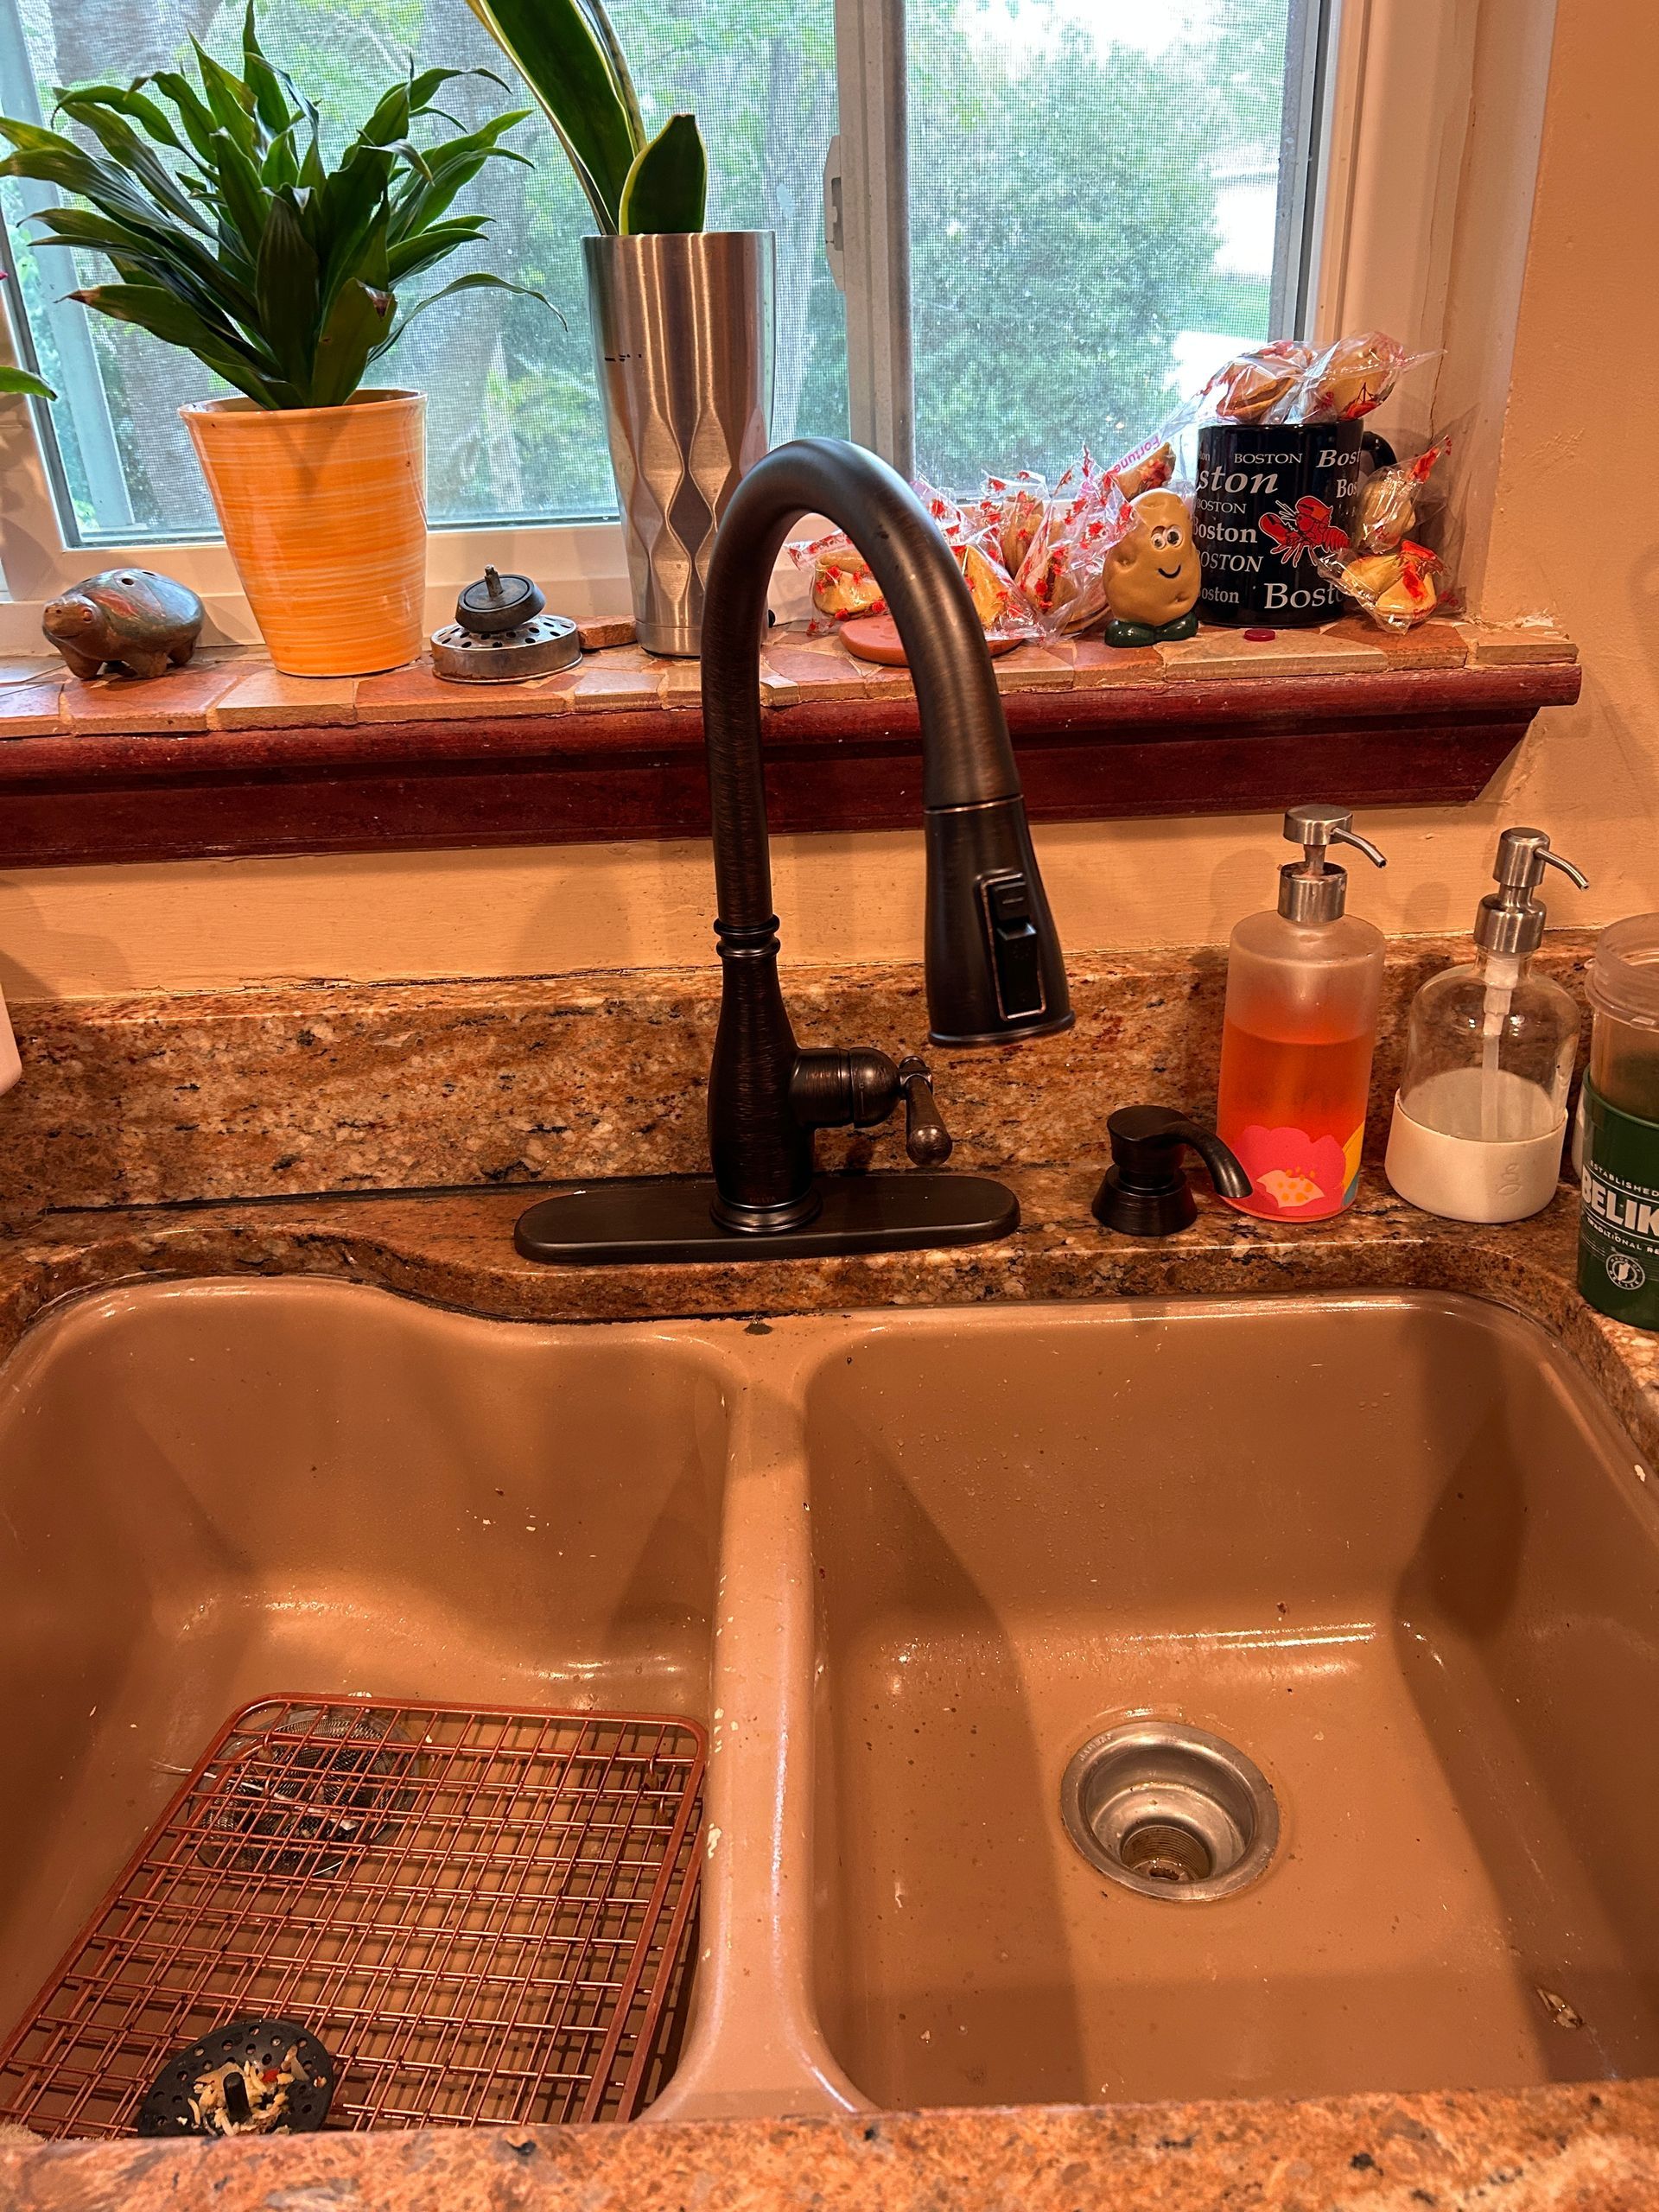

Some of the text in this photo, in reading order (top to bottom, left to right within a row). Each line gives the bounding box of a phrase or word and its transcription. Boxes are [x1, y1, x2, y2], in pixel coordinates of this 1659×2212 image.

[1114, 435, 1160, 474] Fortune
[1234, 453, 1303, 465] BOSTON
[1197, 549, 1264, 572] OSTON
[1199, 587, 1240, 604] oston
[1590, 1160, 1659, 1197] ESTABLISHED
